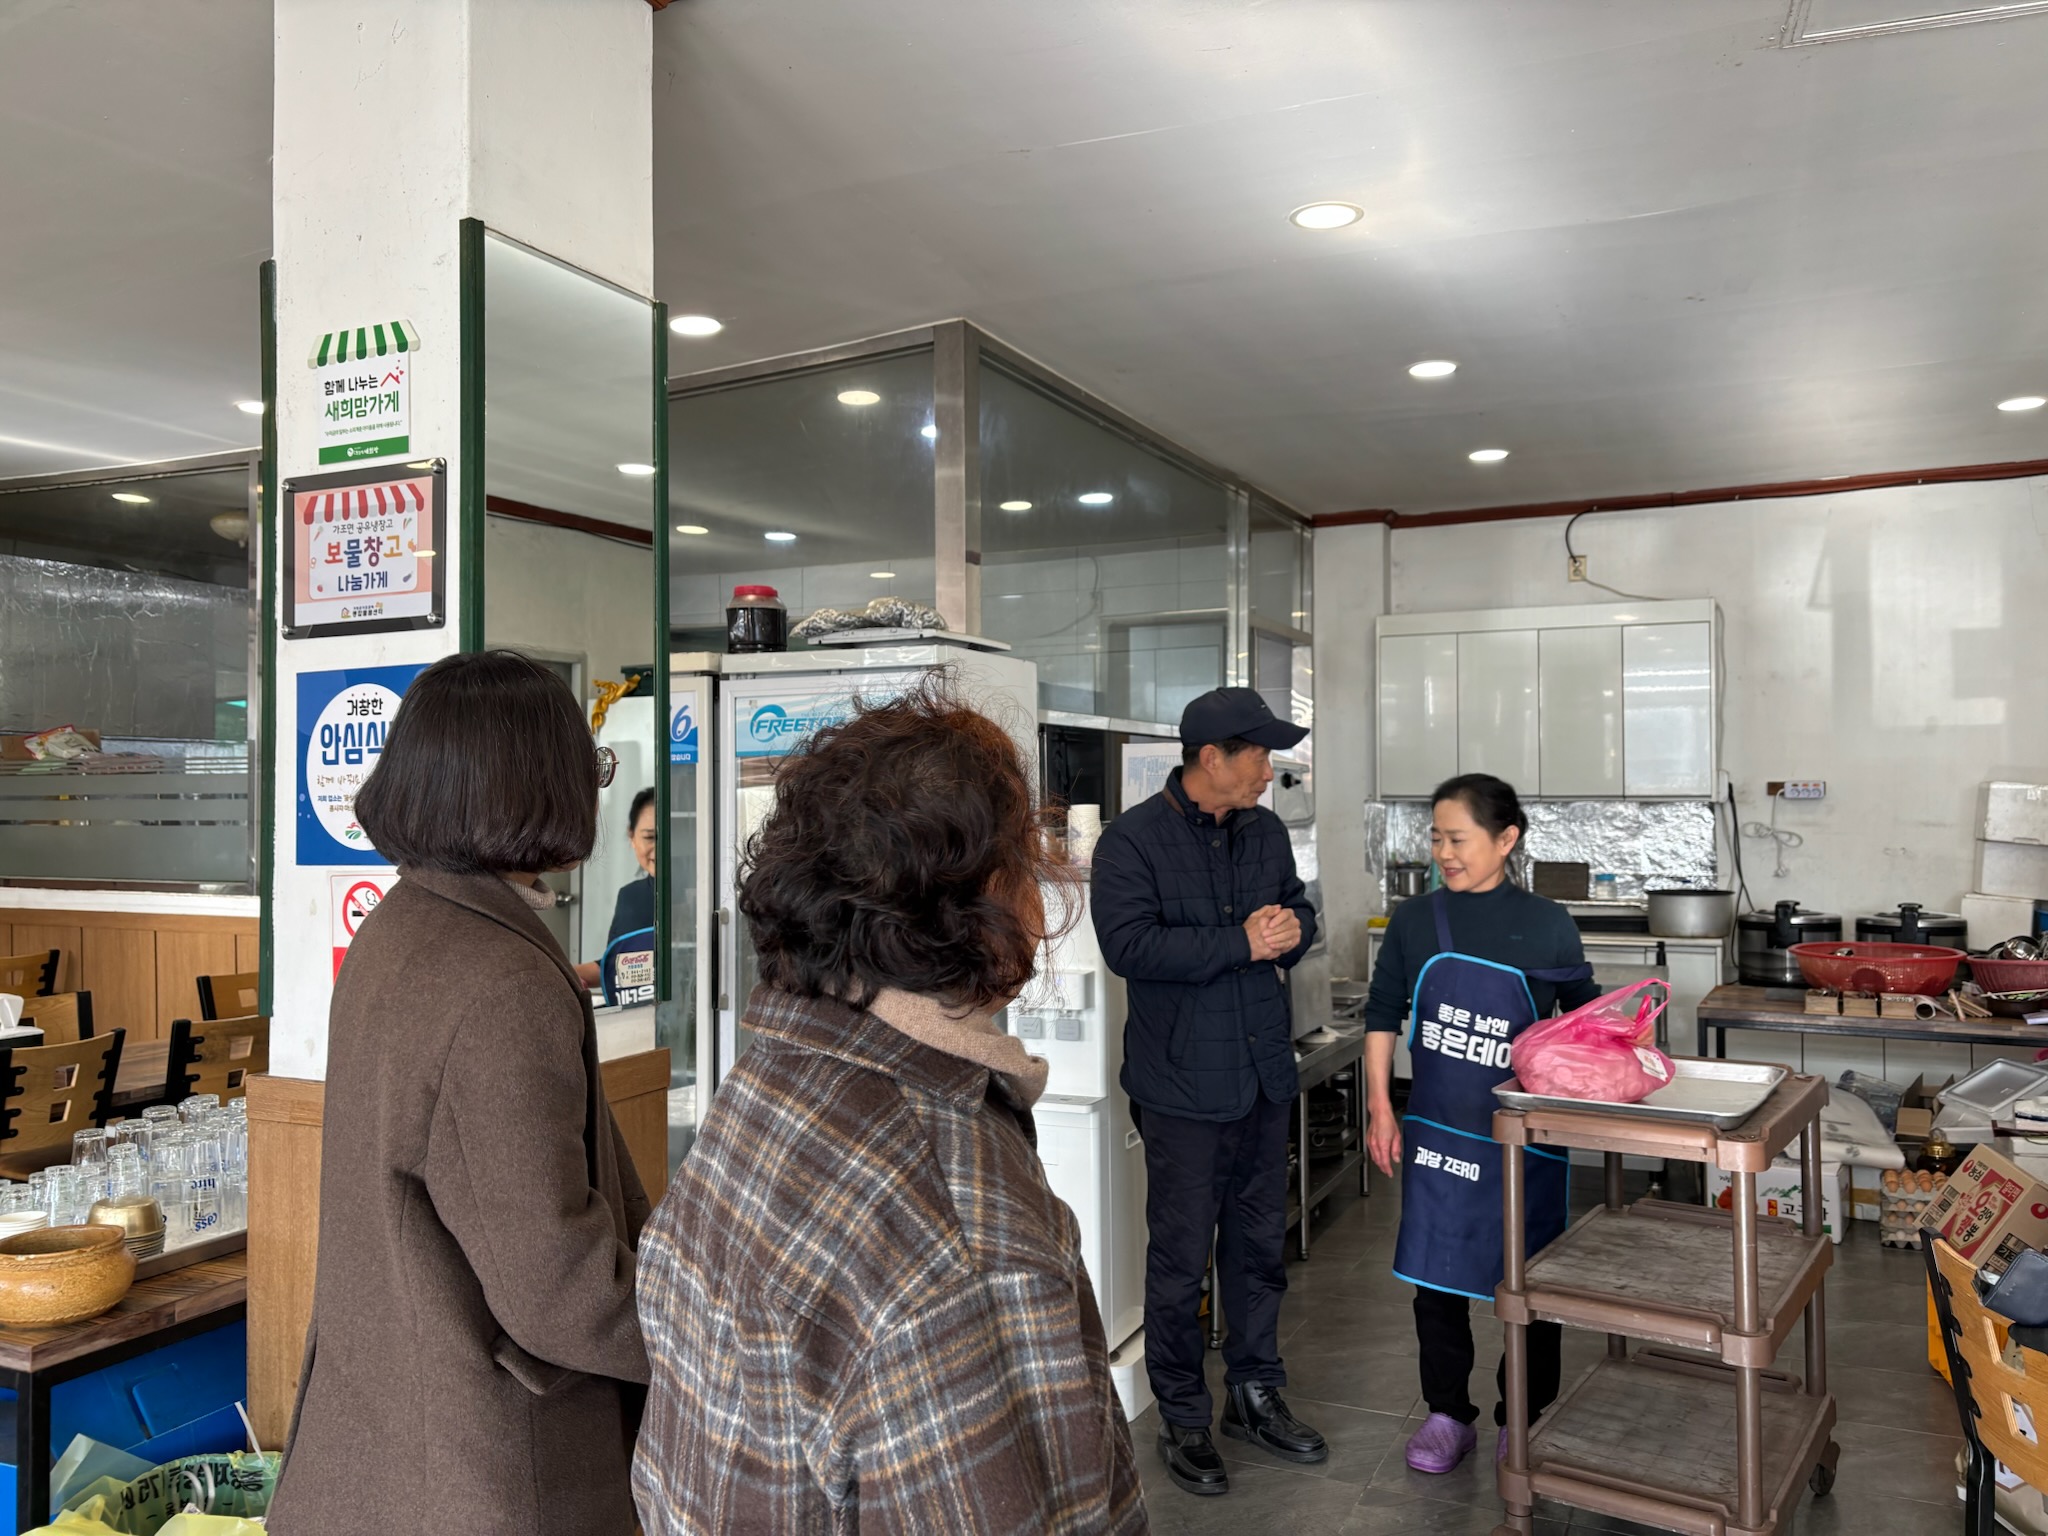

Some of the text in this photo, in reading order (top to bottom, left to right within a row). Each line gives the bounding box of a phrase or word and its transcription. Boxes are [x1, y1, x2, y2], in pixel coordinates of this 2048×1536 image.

[324, 374, 379, 396] 함께 나누는
[324, 390, 399, 421] 새희망가게
[332, 519, 393, 535] 가조면 공유냉장고
[324, 535, 403, 569] 보물창고
[338, 571, 388, 592] 나눔가게
[347, 697, 384, 716] 거창한
[670, 703, 692, 740] 6
[320, 720, 392, 766] 안심식
[317, 774, 335, 788] 함께
[1437, 1002, 1510, 1038] 좋은 날엔
[1414, 1145, 1481, 1182] 과당 ZERO
[1967, 1165, 1985, 1182] 농심
